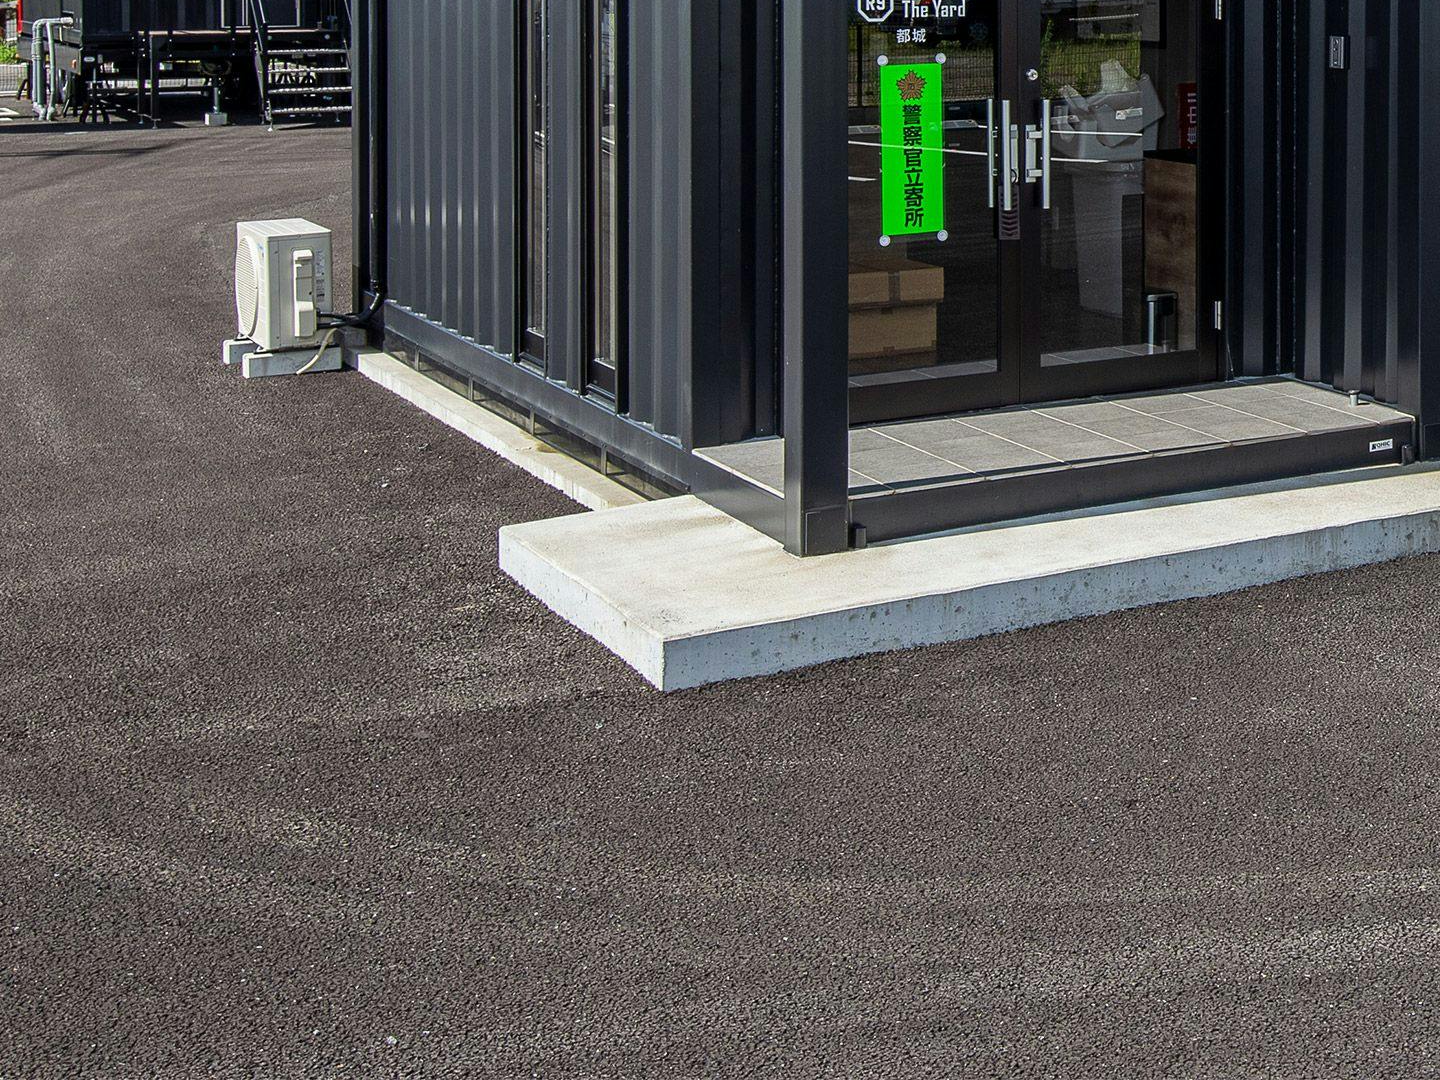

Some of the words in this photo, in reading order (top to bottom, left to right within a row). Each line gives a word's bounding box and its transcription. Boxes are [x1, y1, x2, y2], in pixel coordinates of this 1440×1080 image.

[901, 0, 929, 18] The
[932, 0, 966, 18] Yard
[896, 28, 926, 44] 都城
[902, 103, 924, 229] 警察官立寄所
